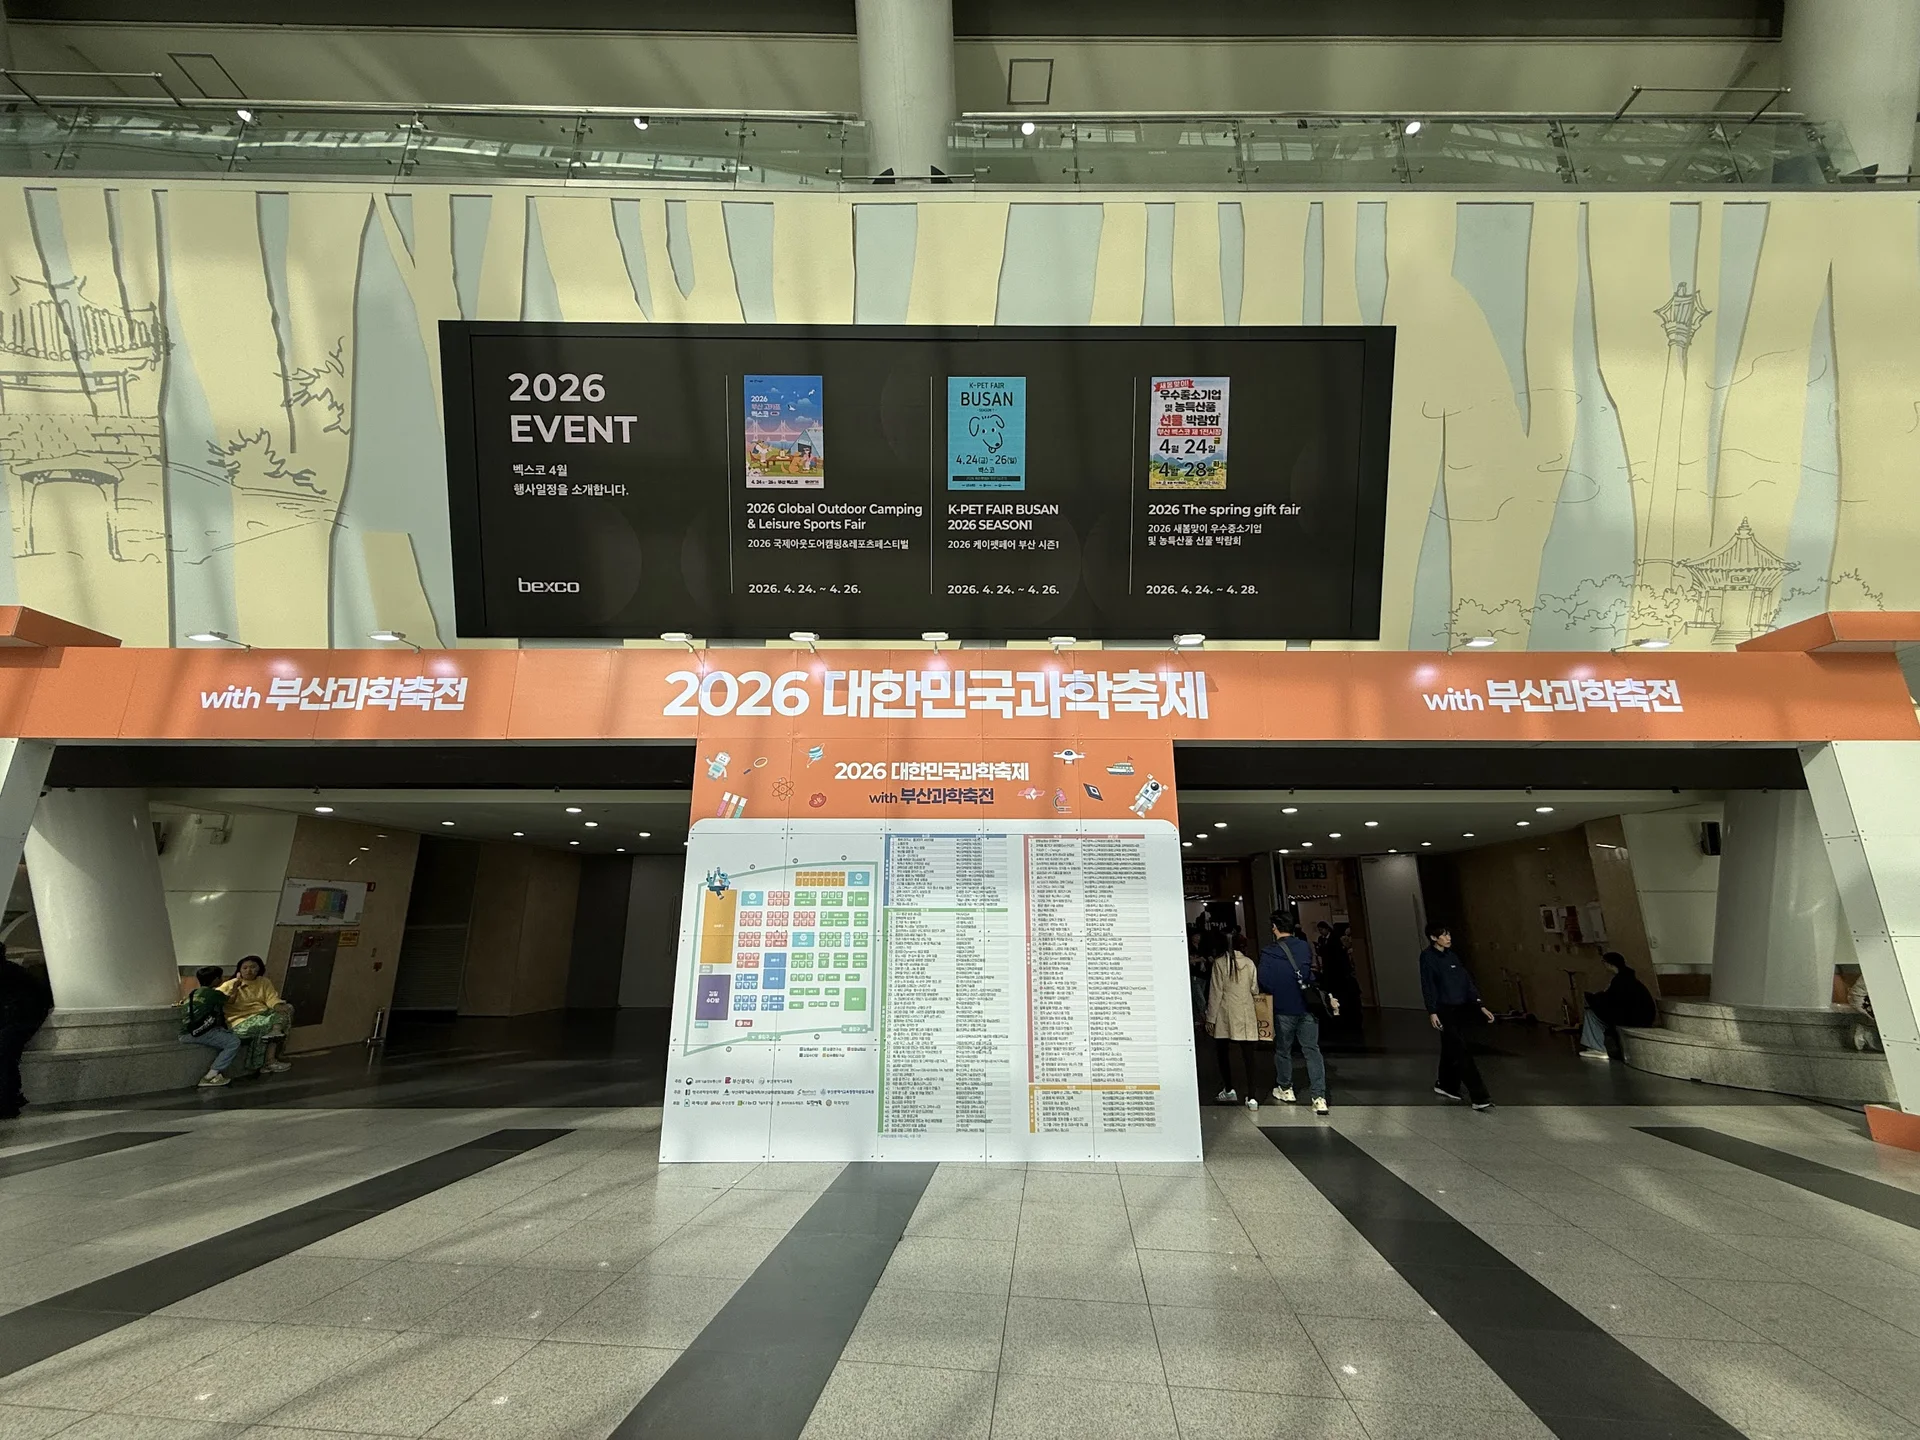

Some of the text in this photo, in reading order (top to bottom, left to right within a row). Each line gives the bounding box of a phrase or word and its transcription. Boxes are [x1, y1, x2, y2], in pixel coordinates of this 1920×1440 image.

[508, 373, 605, 402] 2026
[961, 392, 1013, 406] BUSAN
[1160, 390, 1221, 400] 우수중소기업
[1175, 403, 1216, 412] 농특산품
[1160, 415, 1219, 426] 선물 박람회
[511, 415, 637, 443] EVENT
[1160, 439, 1179, 453] 4월
[1185, 439, 1216, 453] 24일
[513, 464, 567, 476] 벡스코 4월
[514, 484, 628, 496] 행사일정을 소개합니다.
[747, 503, 922, 517] 2026 Global Outdoor Camping
[949, 504, 1058, 514] K-PET FAIR BUSAN
[1149, 504, 1301, 517] 2026 The spring gift fair
[748, 518, 866, 532] & Leisure Sports Fair
[948, 520, 1032, 530] 2026 SEASON1
[1174, 524, 1207, 533] 새봄맞이
[1210, 524, 1261, 533] 우수중소기업
[748, 539, 908, 549] 2026 국제아웃도어캠핑&레포츠페스티벌
[948, 540, 1059, 549] 2026 케이펫페어 부산 시즌1
[1148, 536, 1241, 546] 및 농특산품 선물 박람회
[518, 578, 579, 592] bexco
[749, 584, 780, 593] 2026.
[784, 585, 795, 593] 4.
[798, 585, 816, 593] 24.
[830, 585, 840, 593] 4.
[844, 585, 861, 593] 26.
[948, 585, 979, 594] 2026.
[983, 585, 993, 594] 4.
[997, 585, 1014, 594] 24.
[1028, 585, 1039, 594] 4.
[1042, 585, 1059, 594] 26.
[1147, 585, 1177, 594] 2026.
[1181, 585, 1192, 594] 4.
[1196, 585, 1213, 594] 24.
[1227, 585, 1237, 594] 4.
[1241, 585, 1258, 594] 28.
[201, 676, 468, 711] with 부산과학축전
[663, 670, 1208, 719] 2026 대한민국과학축제
[1423, 678, 1683, 713] with 부산과학축전
[835, 763, 1029, 781] 2026 대한민국과학축제
[870, 788, 994, 805] with 부산과학축전
